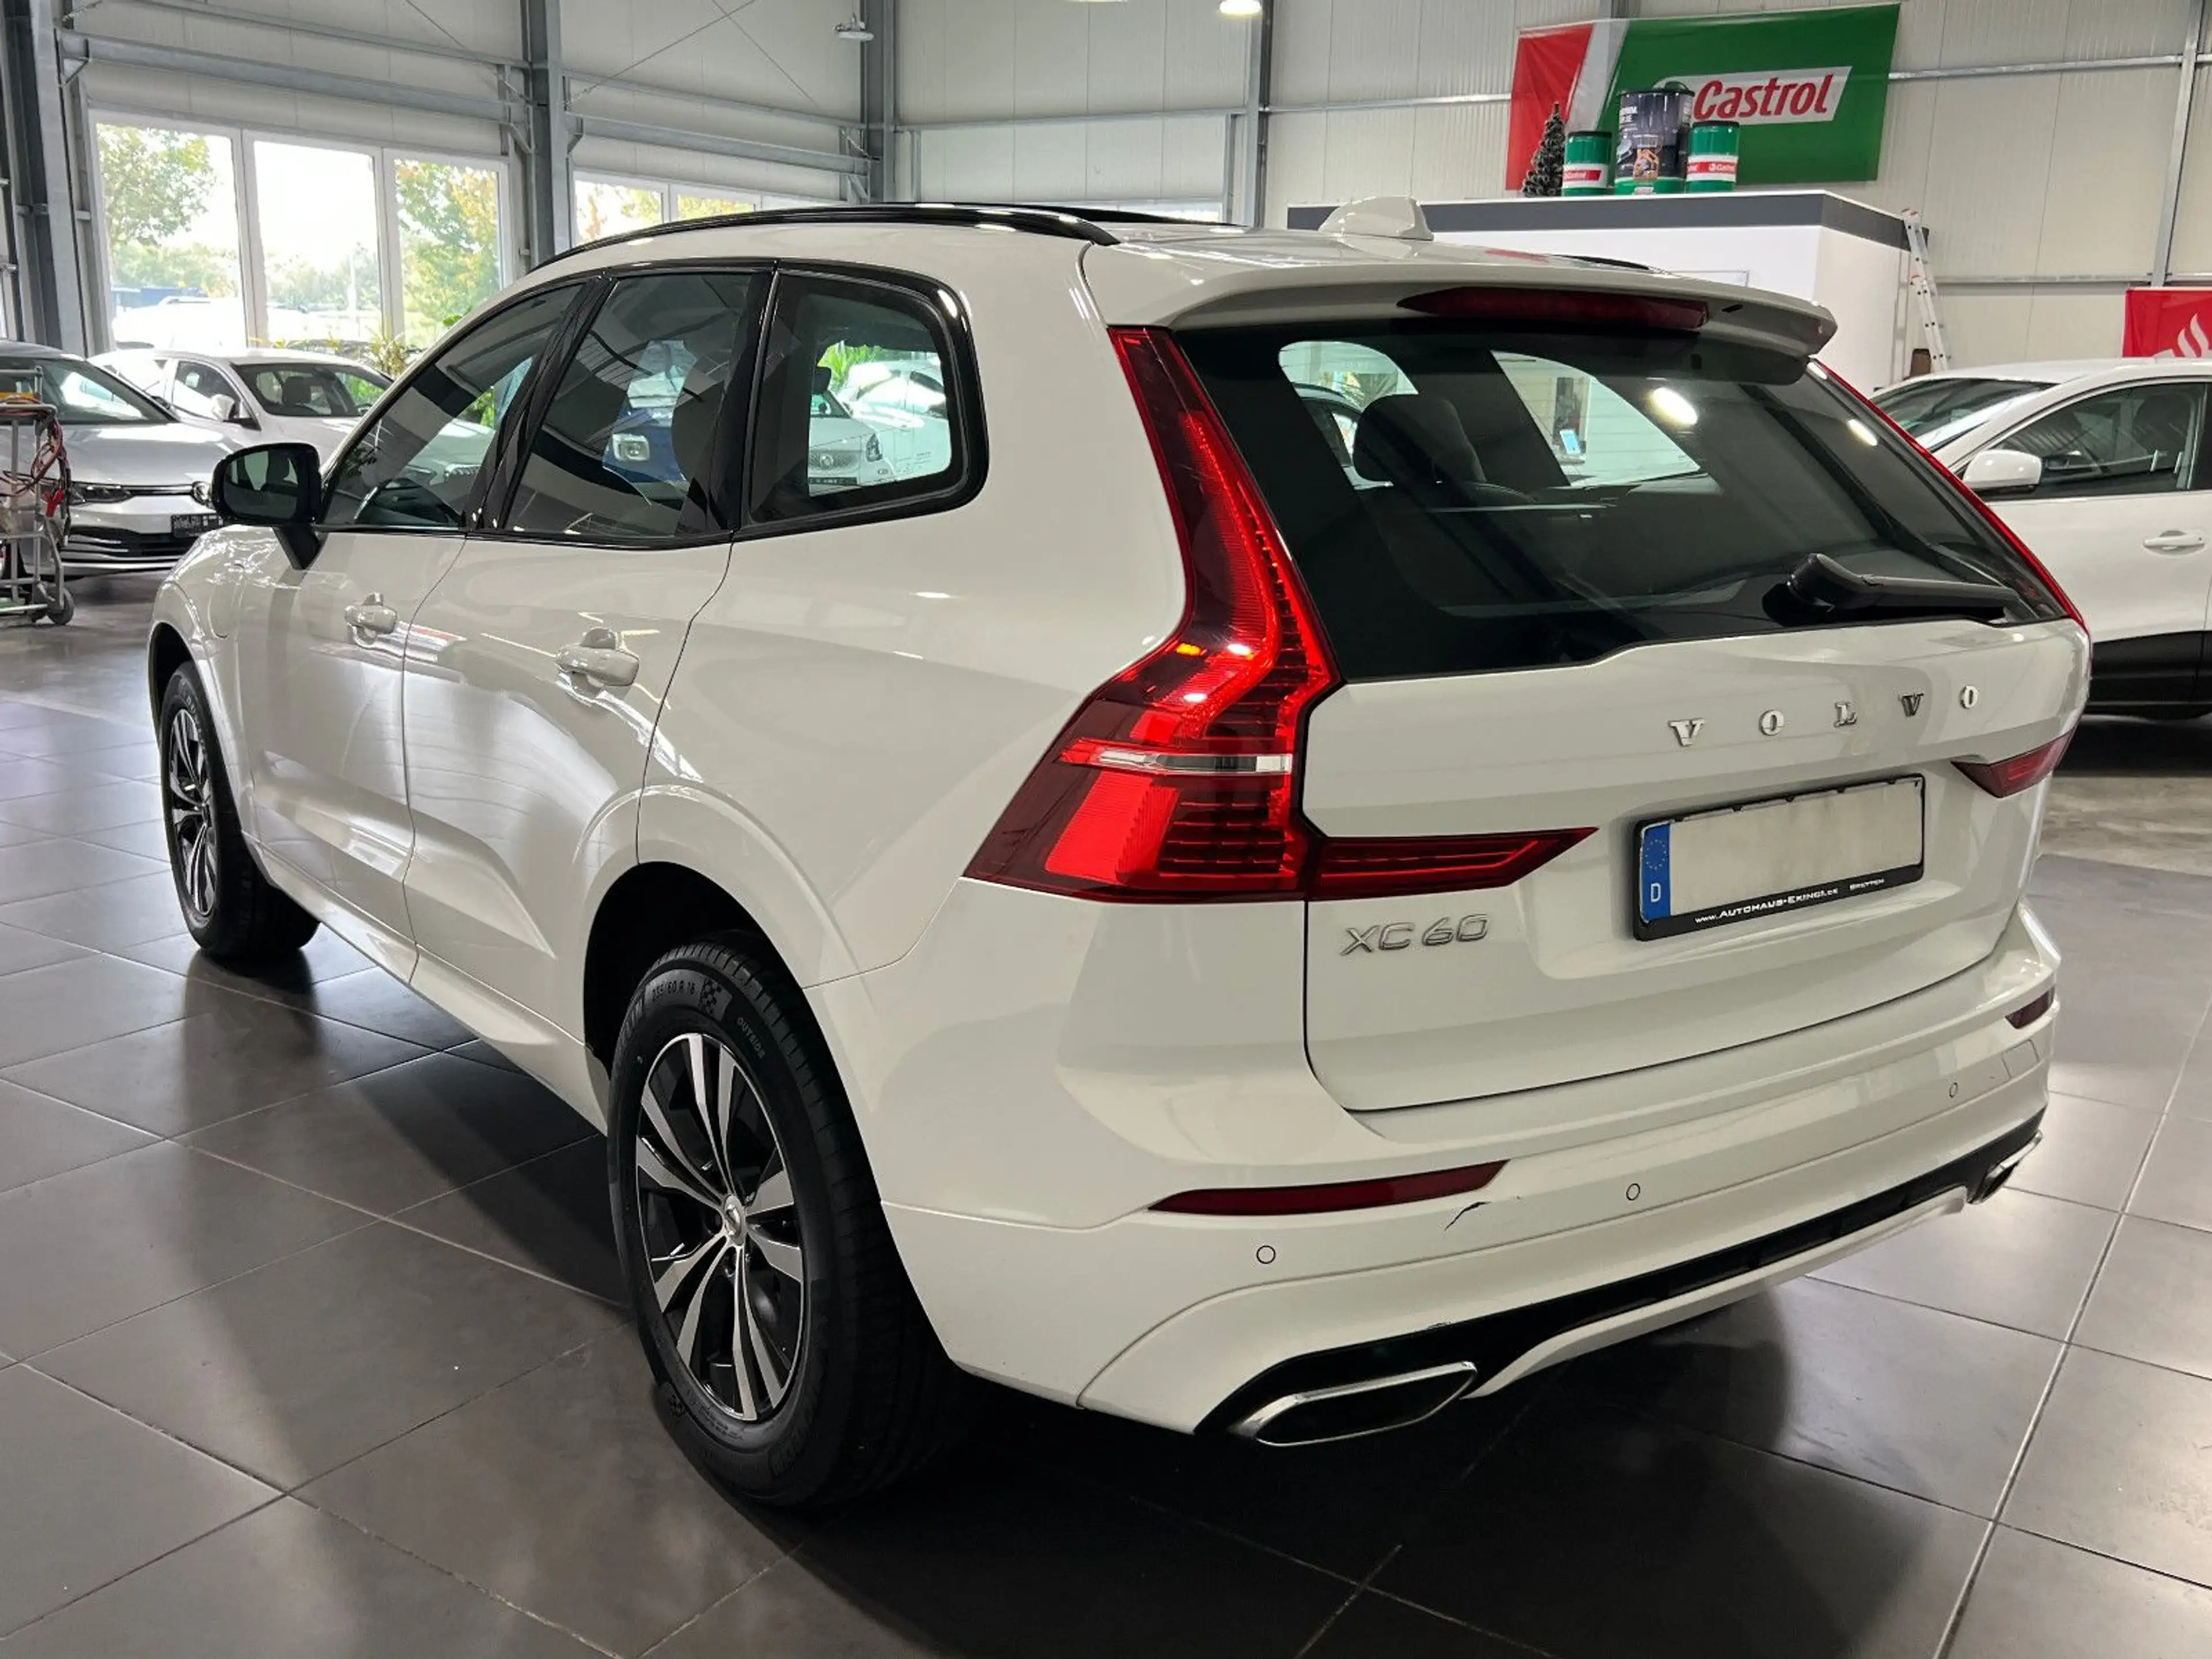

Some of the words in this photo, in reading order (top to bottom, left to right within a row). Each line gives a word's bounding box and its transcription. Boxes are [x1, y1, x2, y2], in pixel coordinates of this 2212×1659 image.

[1694, 73, 1834, 120] Castrol
[1668, 685, 1979, 747] VOLVO
[1651, 882, 1661, 903] D
